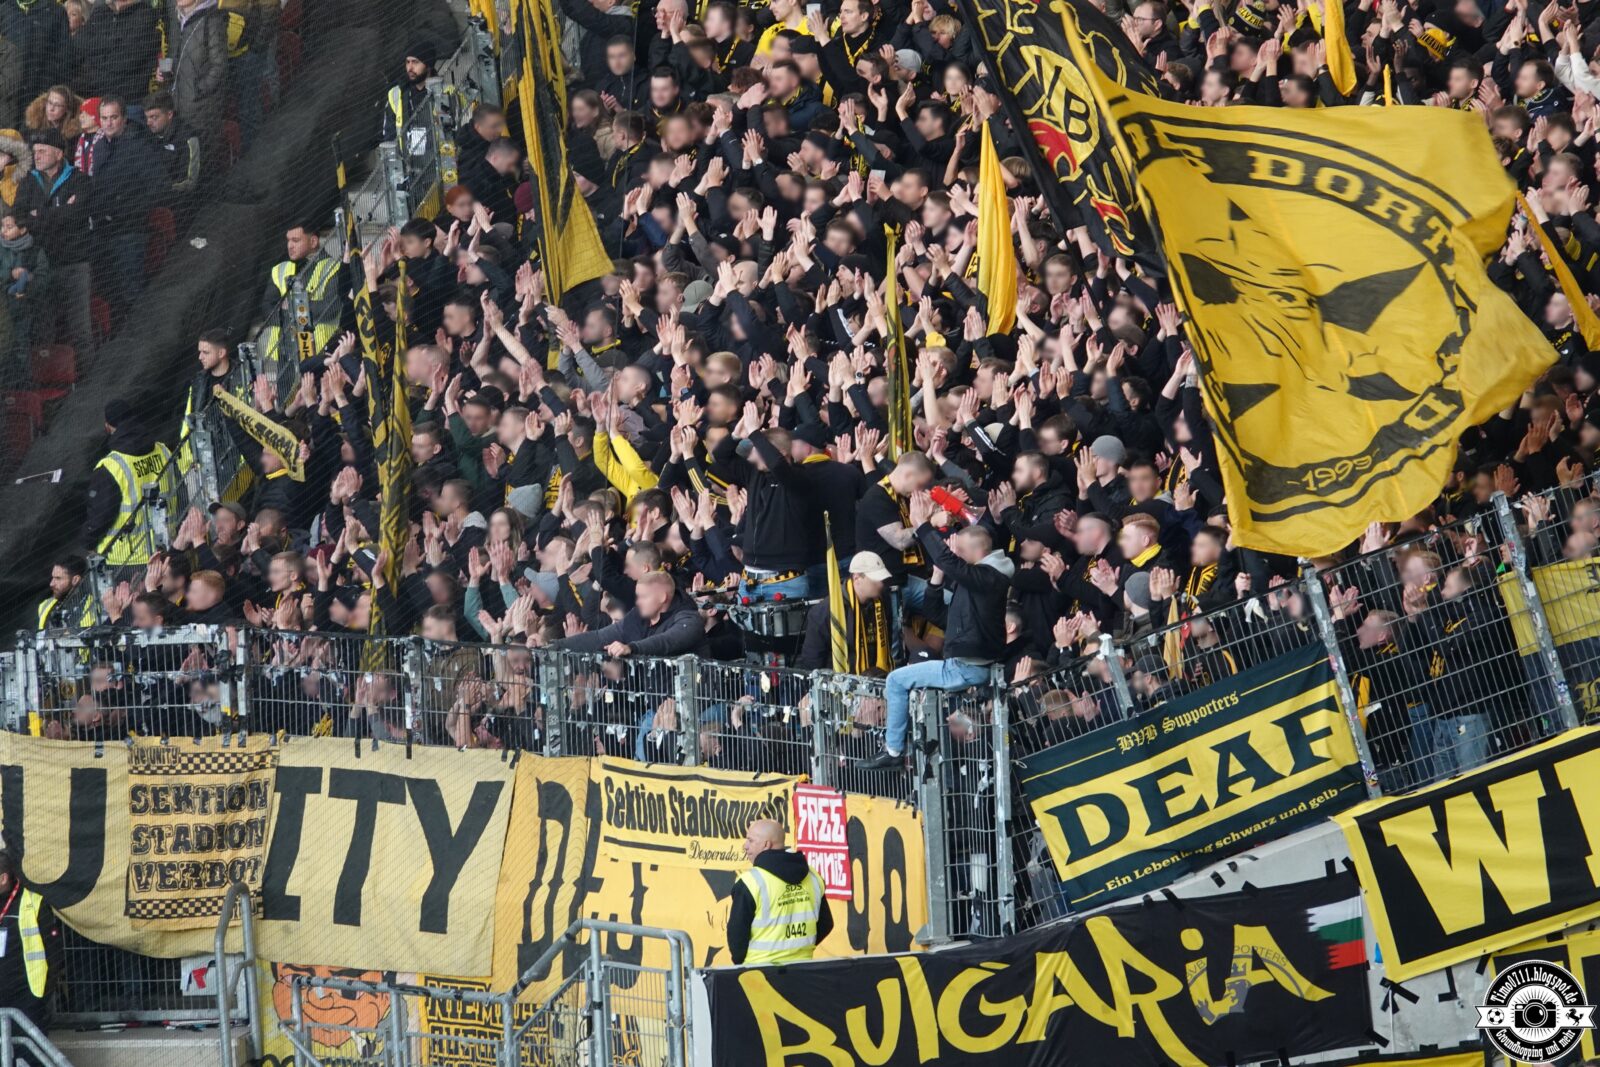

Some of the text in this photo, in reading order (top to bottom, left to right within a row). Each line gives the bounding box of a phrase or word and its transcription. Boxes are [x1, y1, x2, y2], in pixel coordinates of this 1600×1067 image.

[1116, 690, 1239, 755] BVB Supporters
[130, 778, 270, 816] SEKTION
[1044, 694, 1341, 865] DEAF
[604, 776, 668, 833] Sektion
[797, 796, 846, 843] FREE
[1, 765, 505, 934] UITY
[130, 816, 266, 855] STADION
[689, 840, 739, 864] Desperados
[1105, 870, 1131, 891] Ein
[1133, 853, 1181, 880] Leben
[1215, 817, 1277, 850] schwarz
[1279, 801, 1308, 821] und
[1309, 787, 1339, 812] gelb
[131, 854, 263, 893] VERBOT
[785, 922, 807, 939] 0442
